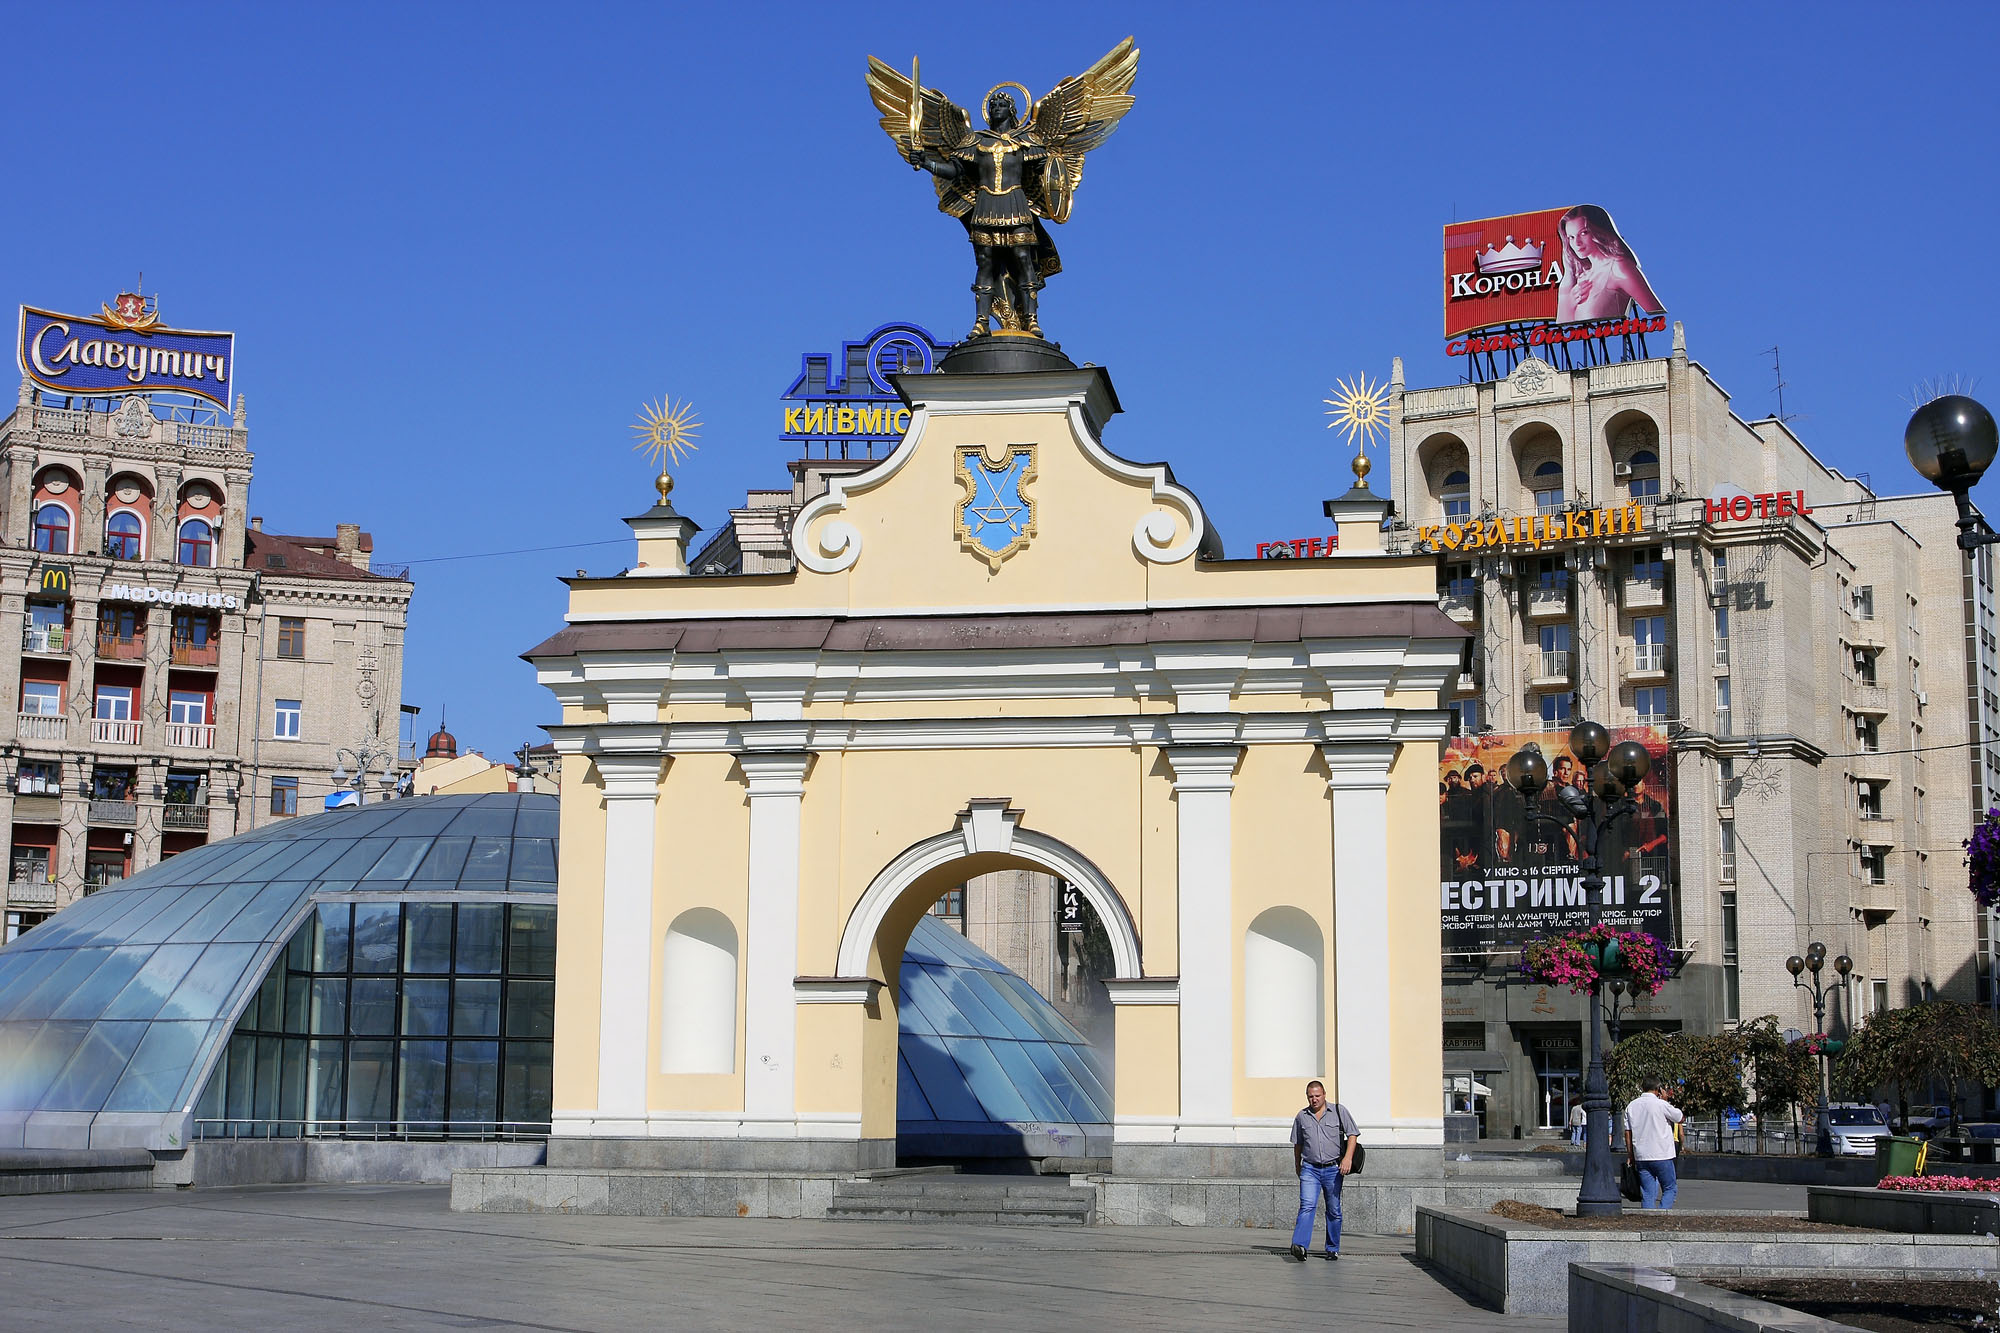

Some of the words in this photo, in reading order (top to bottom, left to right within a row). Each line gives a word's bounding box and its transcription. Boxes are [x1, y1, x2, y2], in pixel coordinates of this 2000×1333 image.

[1445, 332, 1518, 357] смак
[1529, 315, 1667, 345] бажання
[31, 321, 226, 382] Славутич
[1705, 490, 1813, 524] HOTEL
[1418, 499, 1645, 551] КОЗАЦЬКИЙ
[111, 584, 237, 608] McDonald's
[1483, 868, 1491, 877] У
[1495, 867, 1519, 876] КІНО
[1530, 867, 1539, 876] 16
[1639, 874, 1662, 904] 2
[1441, 922, 1474, 930] МСВОРТ
[1517, 920, 1543, 928] ДАММ
[1465, 914, 1495, 922] СТЕТЕМ
[1633, 909, 1662, 917] КУТЮР
[1541, 1039, 1575, 1047] ГОТЕЛЬ
